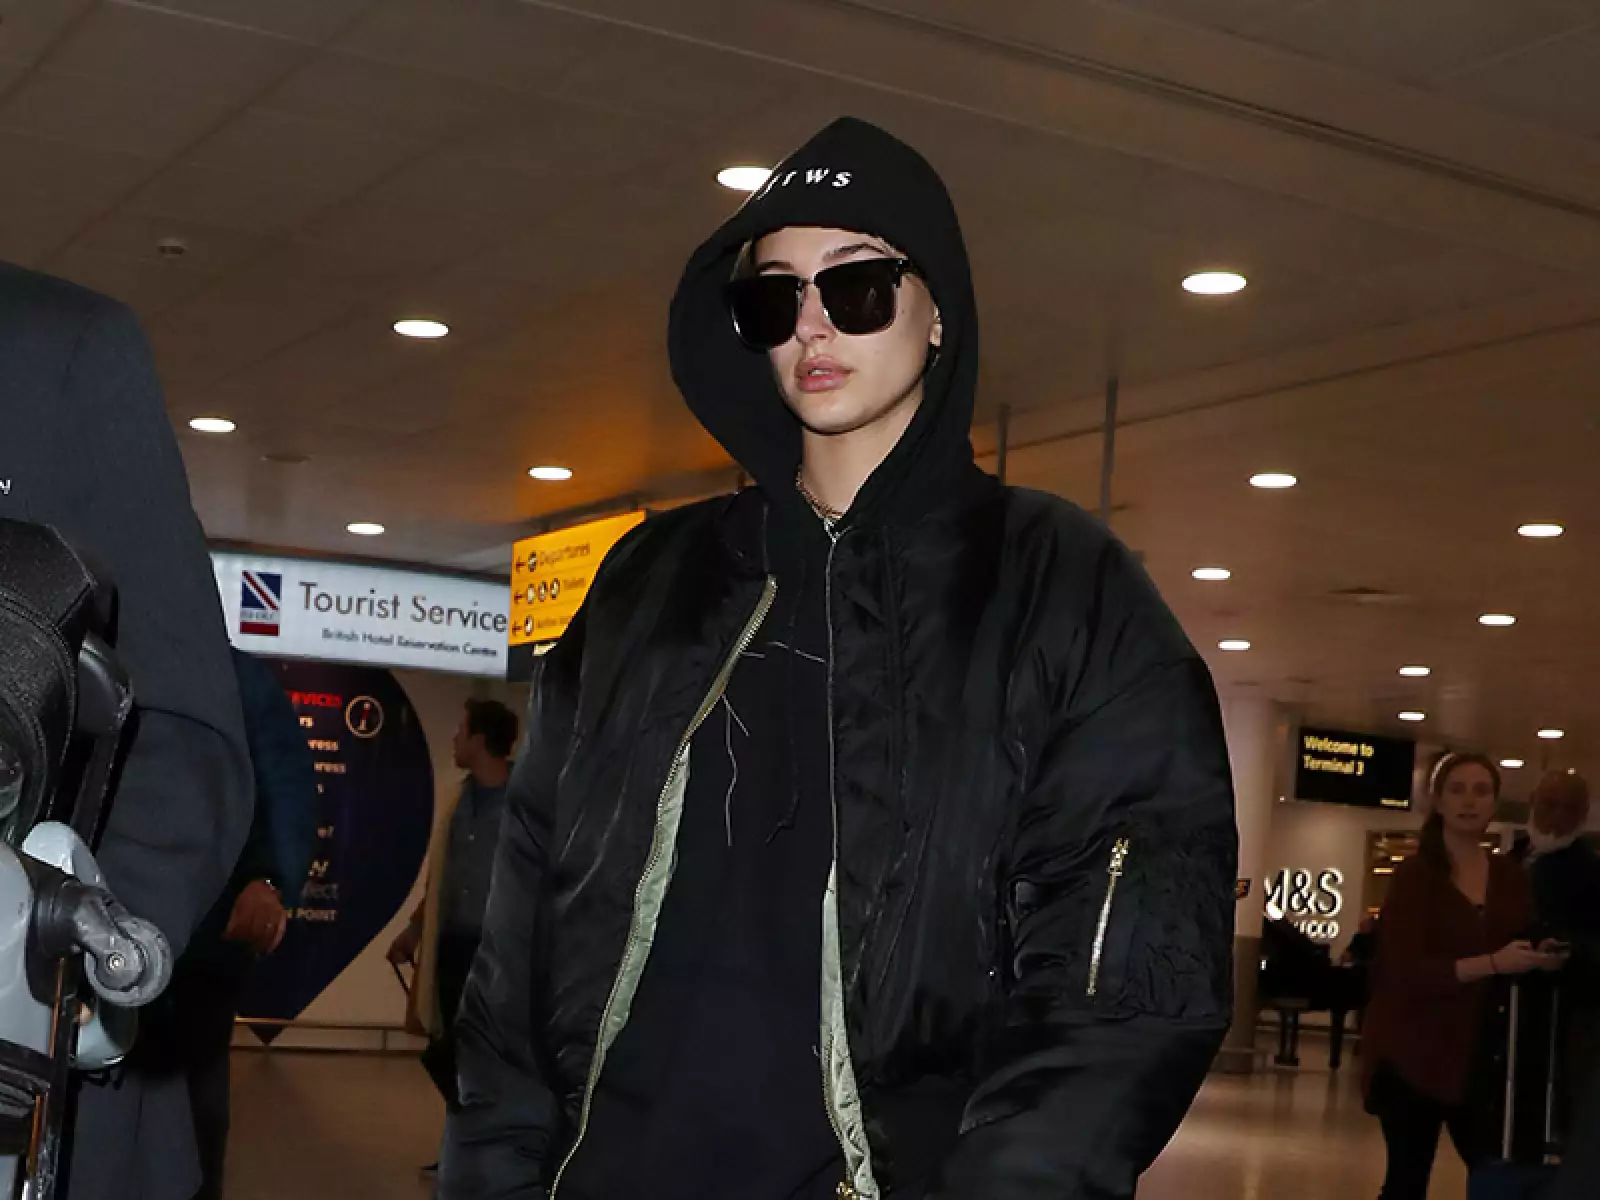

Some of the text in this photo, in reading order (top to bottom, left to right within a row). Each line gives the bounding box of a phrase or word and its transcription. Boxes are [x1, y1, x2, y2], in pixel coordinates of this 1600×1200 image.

[298, 581, 508, 633] Tourist Service
[321, 627, 359, 642] British
[362, 631, 394, 645] Hotel
[1304, 735, 1374, 758] Welcome to
[1304, 754, 1354, 774] Terminal
[1263, 867, 1344, 917] M&S
